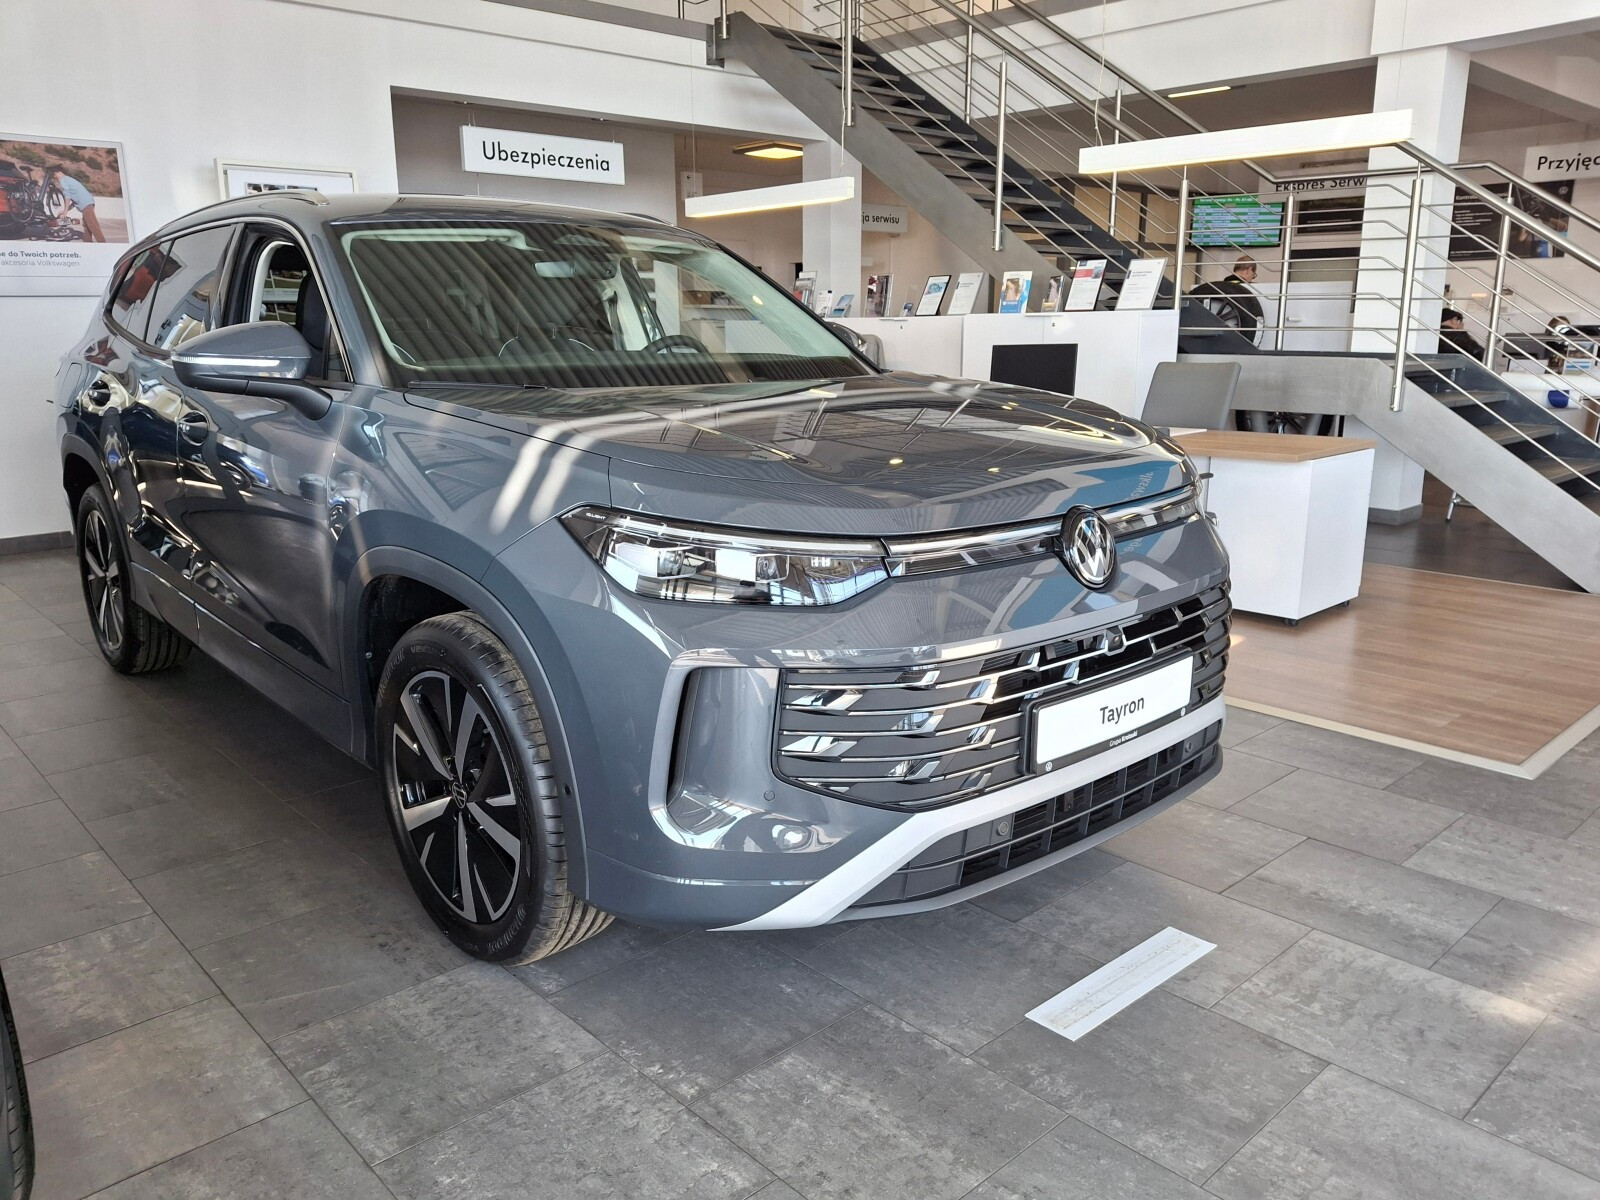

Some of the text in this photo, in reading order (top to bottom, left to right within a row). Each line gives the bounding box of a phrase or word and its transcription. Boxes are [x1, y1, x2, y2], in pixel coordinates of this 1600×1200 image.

[482, 141, 610, 172] Ubezpieczenia
[861, 211, 900, 225] ja serwisu
[49, 251, 81, 259] potrzeb.
[1099, 697, 1145, 725] Tayron
